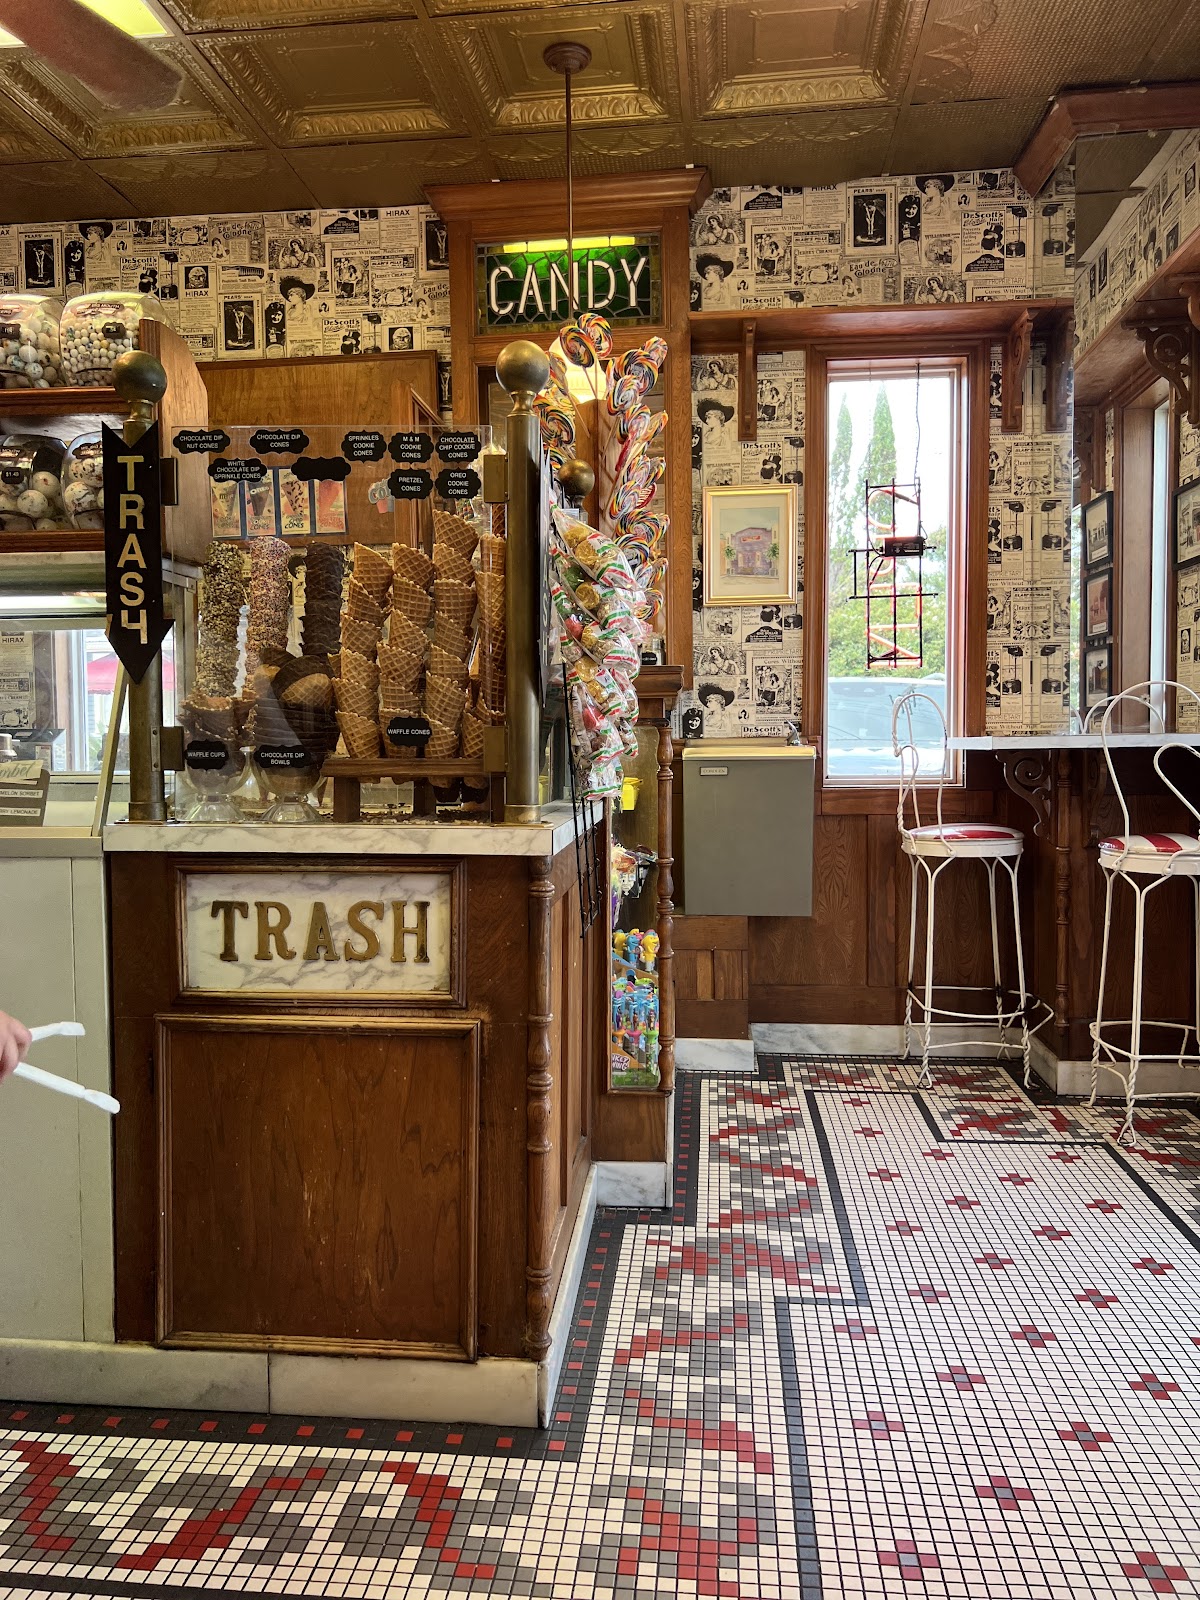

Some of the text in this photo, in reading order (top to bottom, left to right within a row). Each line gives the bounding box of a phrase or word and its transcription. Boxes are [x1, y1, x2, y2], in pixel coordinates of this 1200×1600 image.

[385, 209, 411, 217] HIRAX
[490, 257, 647, 315] CANDY
[179, 434, 213, 442] CHOCOLATE
[348, 434, 380, 442] SPRINKLES
[210, 750, 226, 758] CUPS
[270, 758, 291, 766] BOWLS
[210, 900, 431, 963] TRASH
